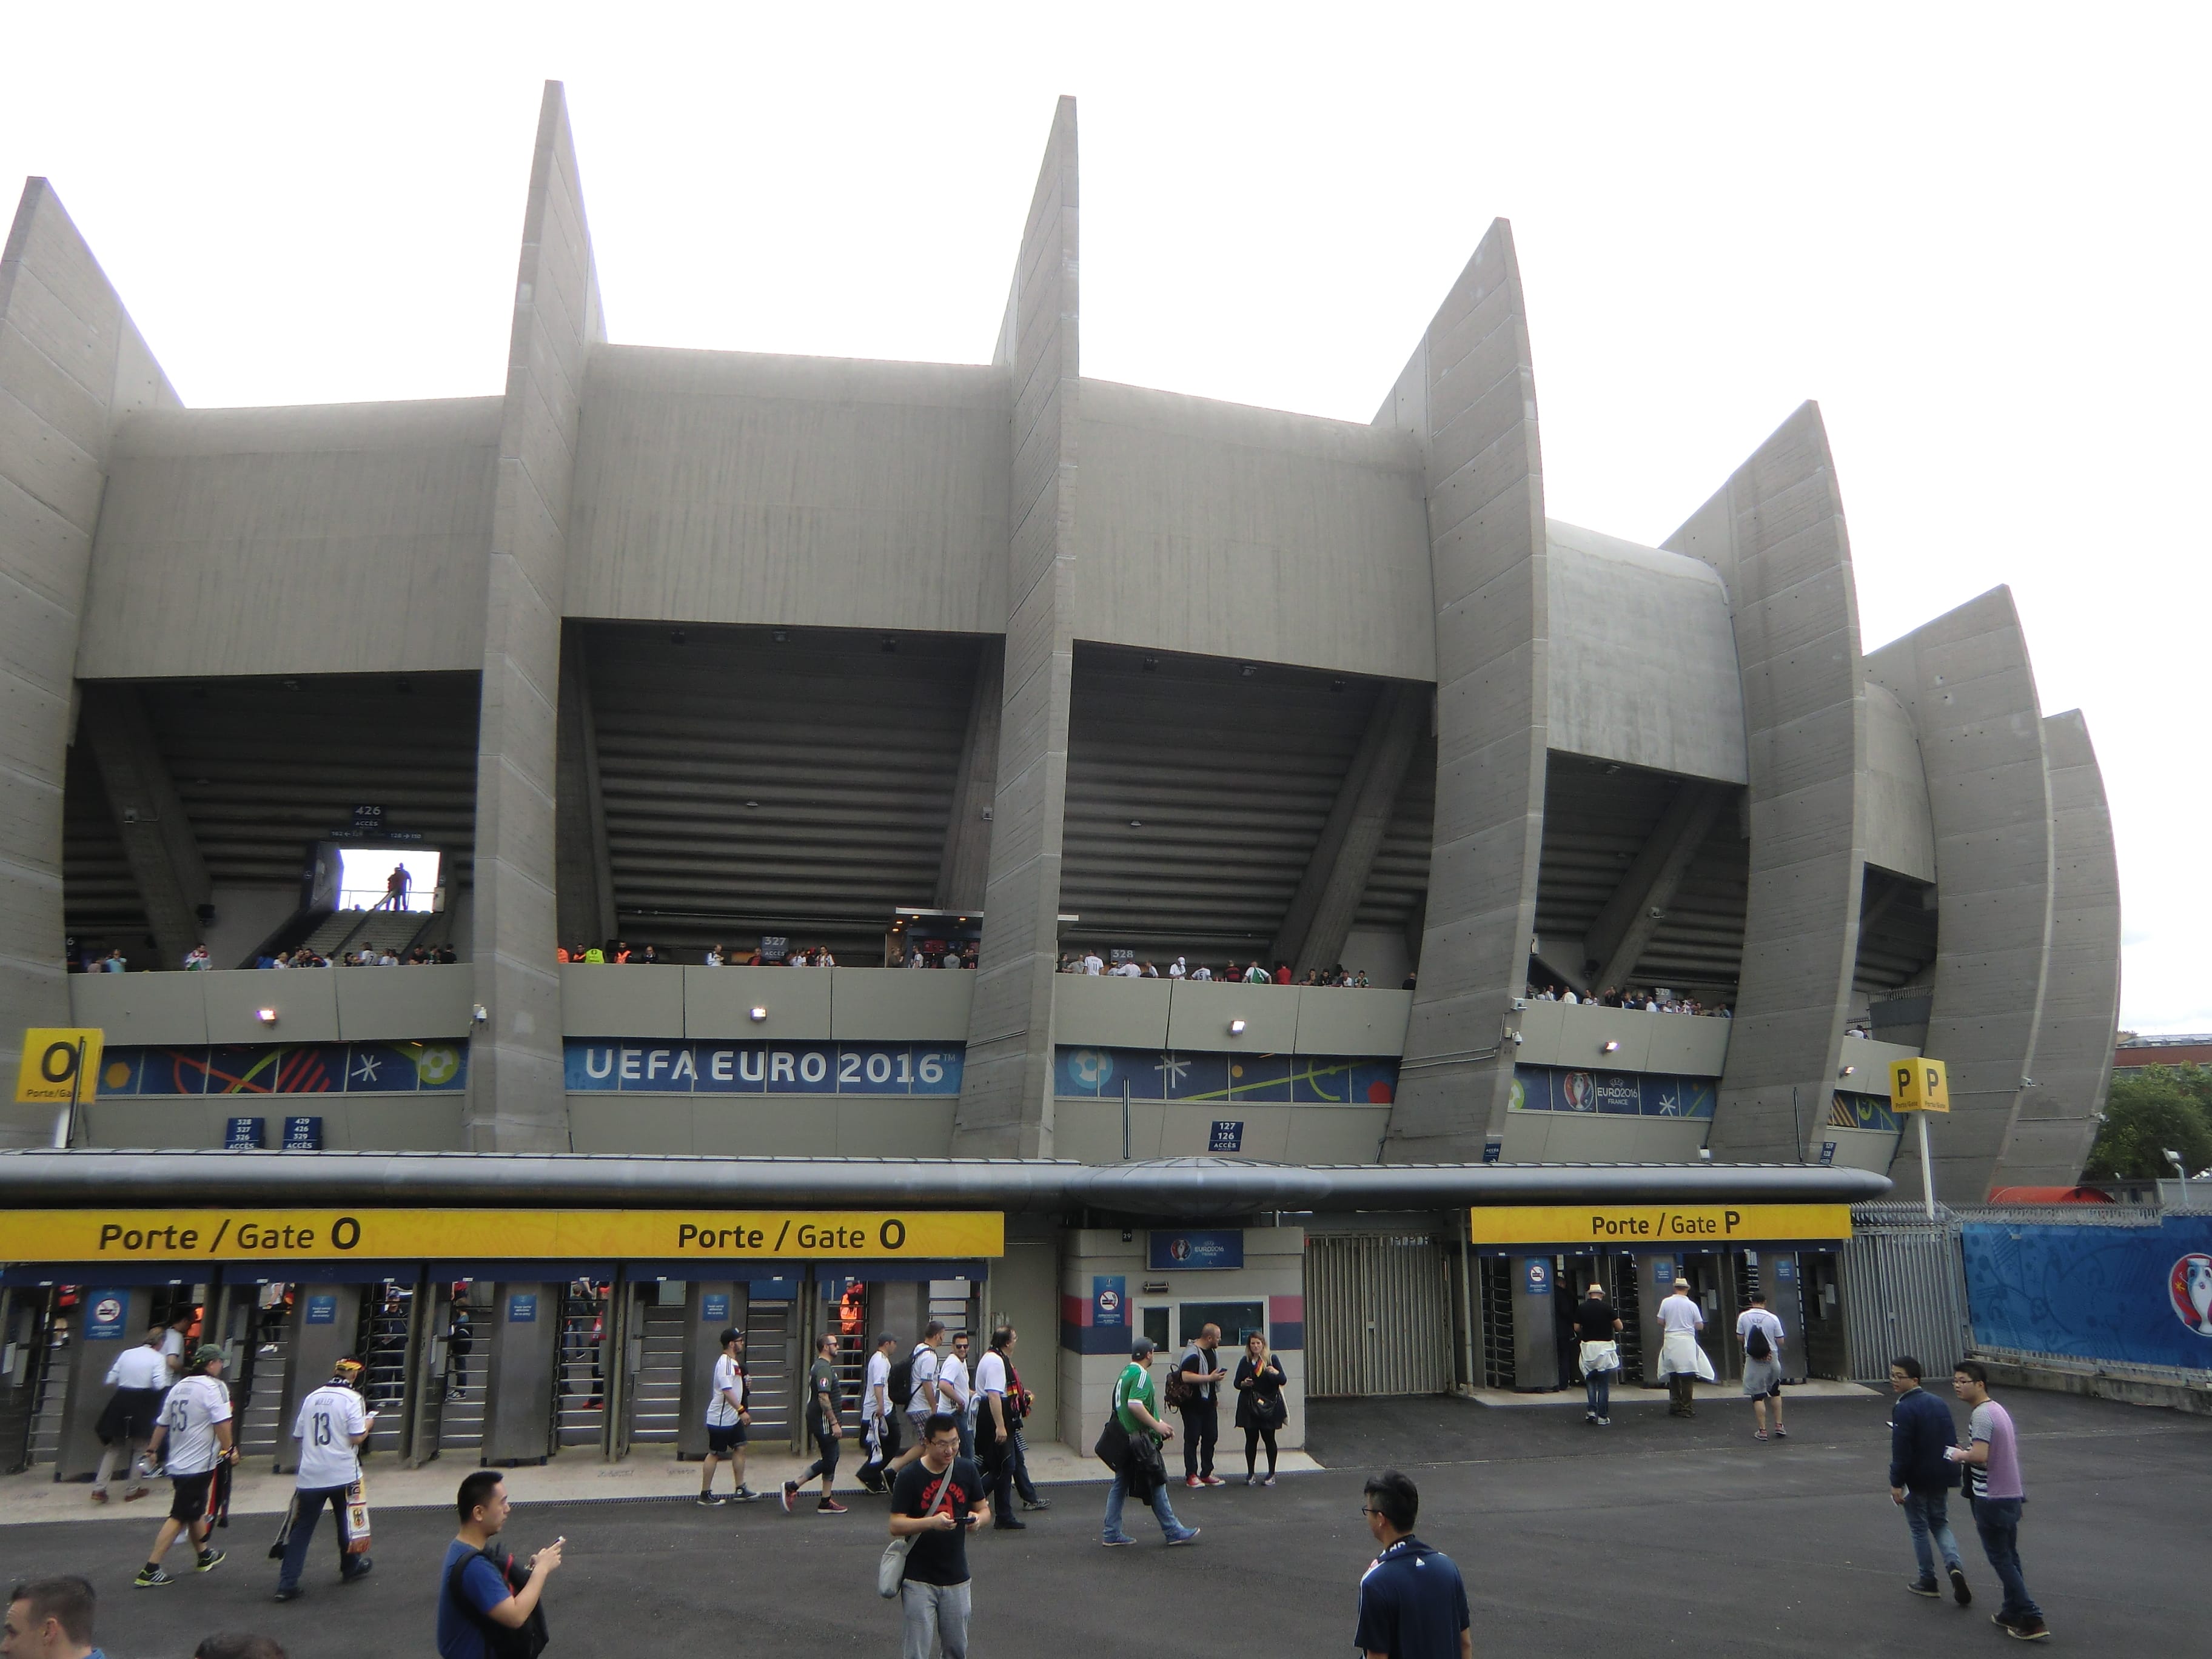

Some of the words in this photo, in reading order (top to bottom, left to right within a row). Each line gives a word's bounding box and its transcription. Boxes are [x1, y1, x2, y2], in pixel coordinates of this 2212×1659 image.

[355, 806, 381, 816] 426
[765, 936, 786, 946] 327
[1112, 949, 1134, 958] 328
[41, 1041, 79, 1083] O
[585, 1048, 699, 1079] UEFA
[711, 1050, 827, 1082] EURO
[839, 1053, 944, 1083] 2016
[1897, 1068, 1911, 1098] P
[1926, 1068, 1939, 1097] P
[1219, 1122, 1236, 1130] 127
[99, 1224, 199, 1250] Porte
[209, 1219, 231, 1253] /
[237, 1223, 315, 1249] Gate
[330, 1216, 361, 1250] O
[679, 1224, 764, 1248] Porte
[774, 1220, 791, 1252] /
[797, 1224, 866, 1248] Gate
[879, 1219, 906, 1250] O
[1592, 1216, 1649, 1235] Porte
[1656, 1212, 1666, 1236] /
[1671, 1215, 1717, 1234] Gate
[1724, 1211, 1741, 1234] P
[312, 1412, 331, 1446] 13
